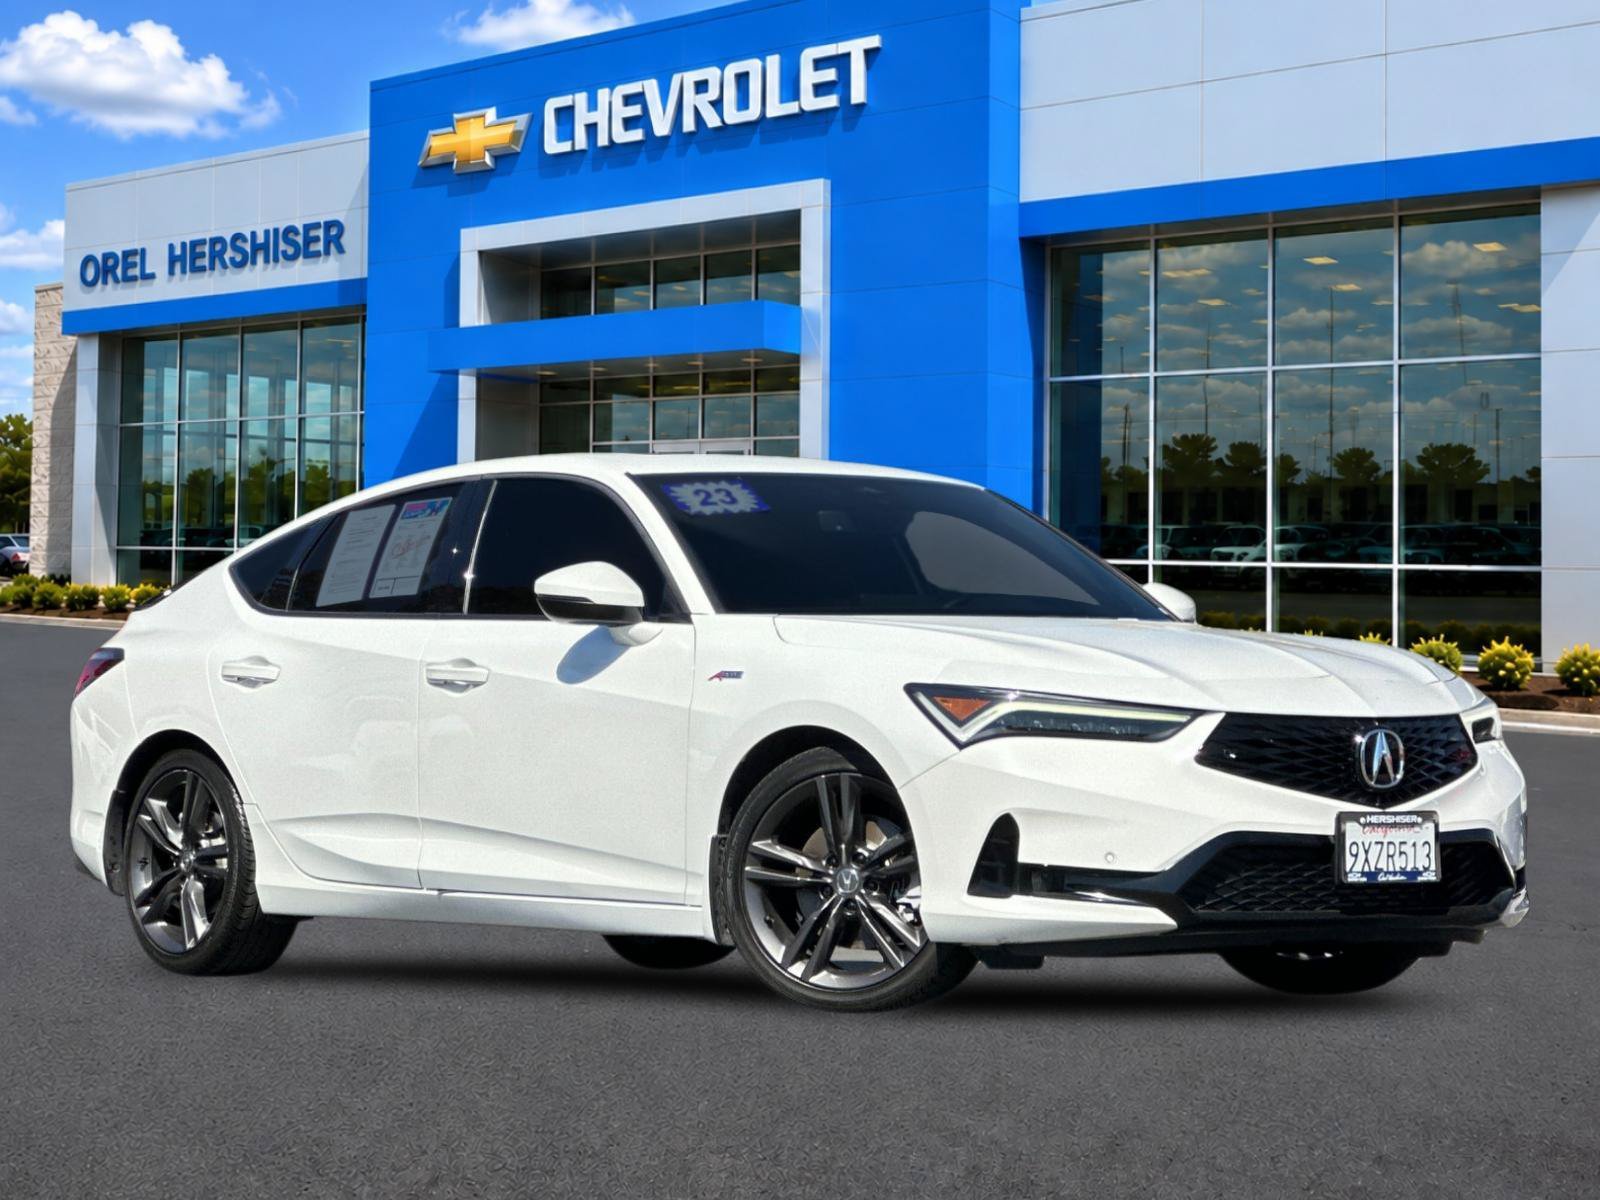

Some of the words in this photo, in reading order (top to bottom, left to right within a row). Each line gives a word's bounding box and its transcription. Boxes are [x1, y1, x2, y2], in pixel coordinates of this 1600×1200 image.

[544, 34, 881, 154] CHEVROLET
[80, 247, 156, 287] OREL
[167, 219, 346, 276] HERSHISER
[693, 488, 738, 506] 23
[1366, 814, 1418, 824] HERSHISER
[1348, 841, 1432, 872] 9XZR513
